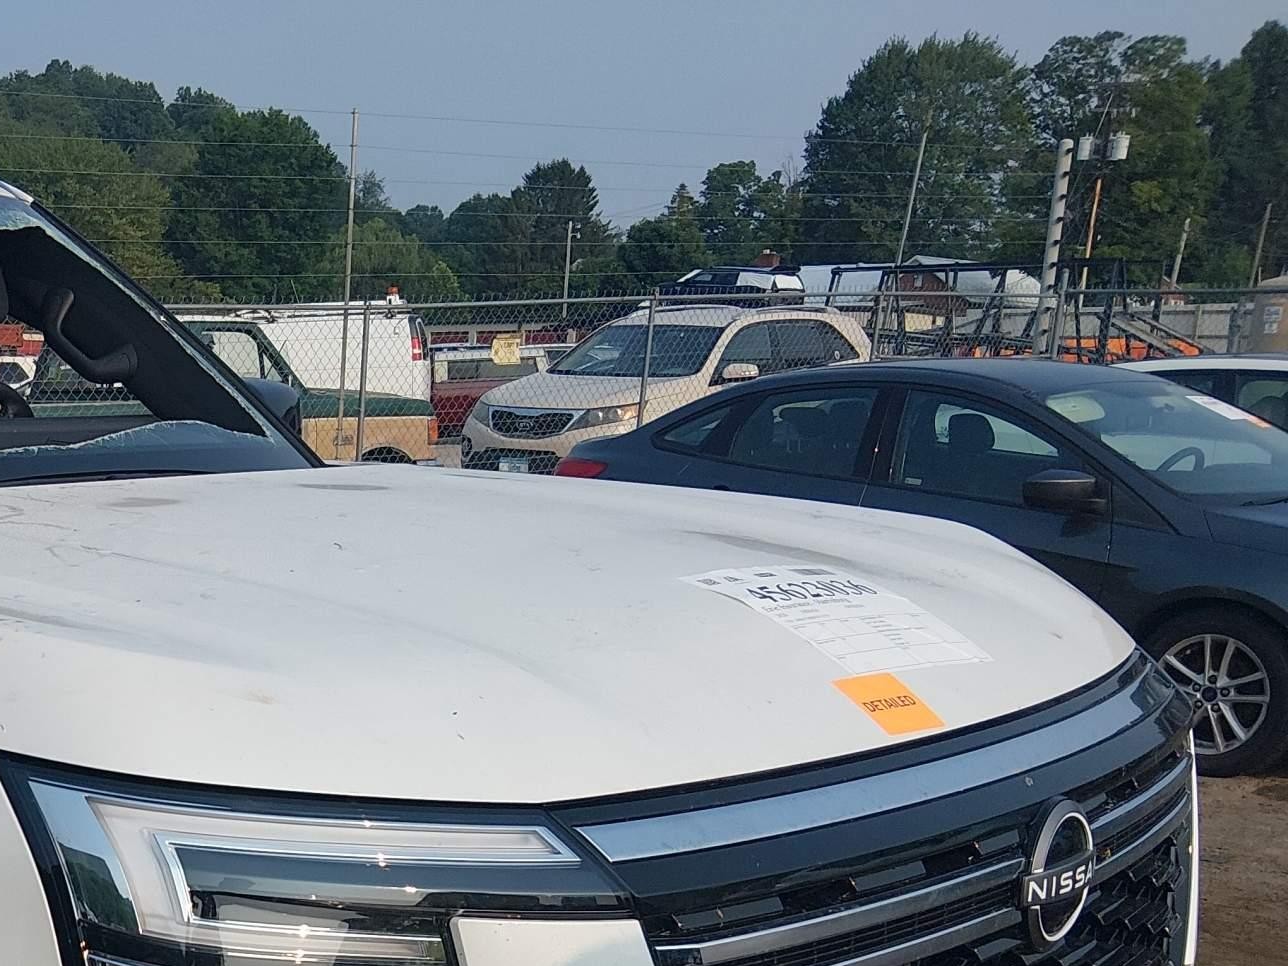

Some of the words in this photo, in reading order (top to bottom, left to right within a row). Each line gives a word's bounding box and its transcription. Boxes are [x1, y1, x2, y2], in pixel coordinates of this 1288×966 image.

[746, 580, 877, 602] 45623036
[862, 695, 916, 712] DETAILED
[1027, 860, 1094, 903] NISSA
